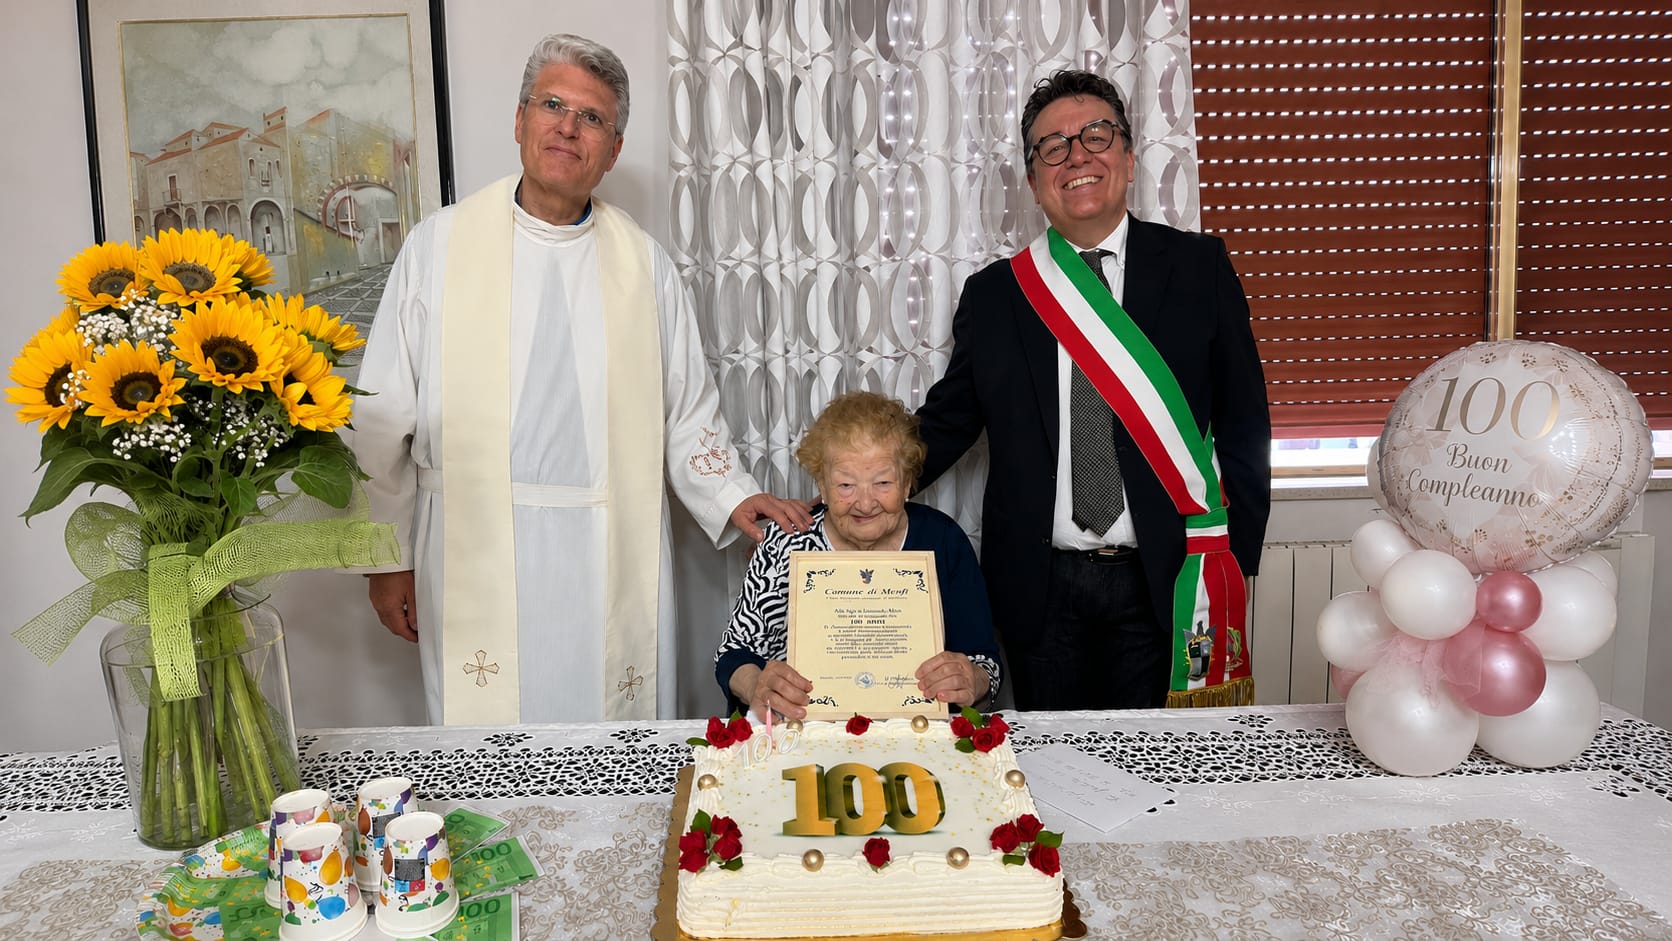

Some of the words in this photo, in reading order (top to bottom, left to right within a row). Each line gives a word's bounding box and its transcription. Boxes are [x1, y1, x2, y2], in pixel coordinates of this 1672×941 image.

[1426, 376, 1560, 440] 100
[1446, 443, 1512, 474] Buon
[1408, 468, 1542, 508] Compleanno
[880, 588, 909, 596] Menfi
[737, 729, 801, 768] 100
[781, 761, 946, 837] 100
